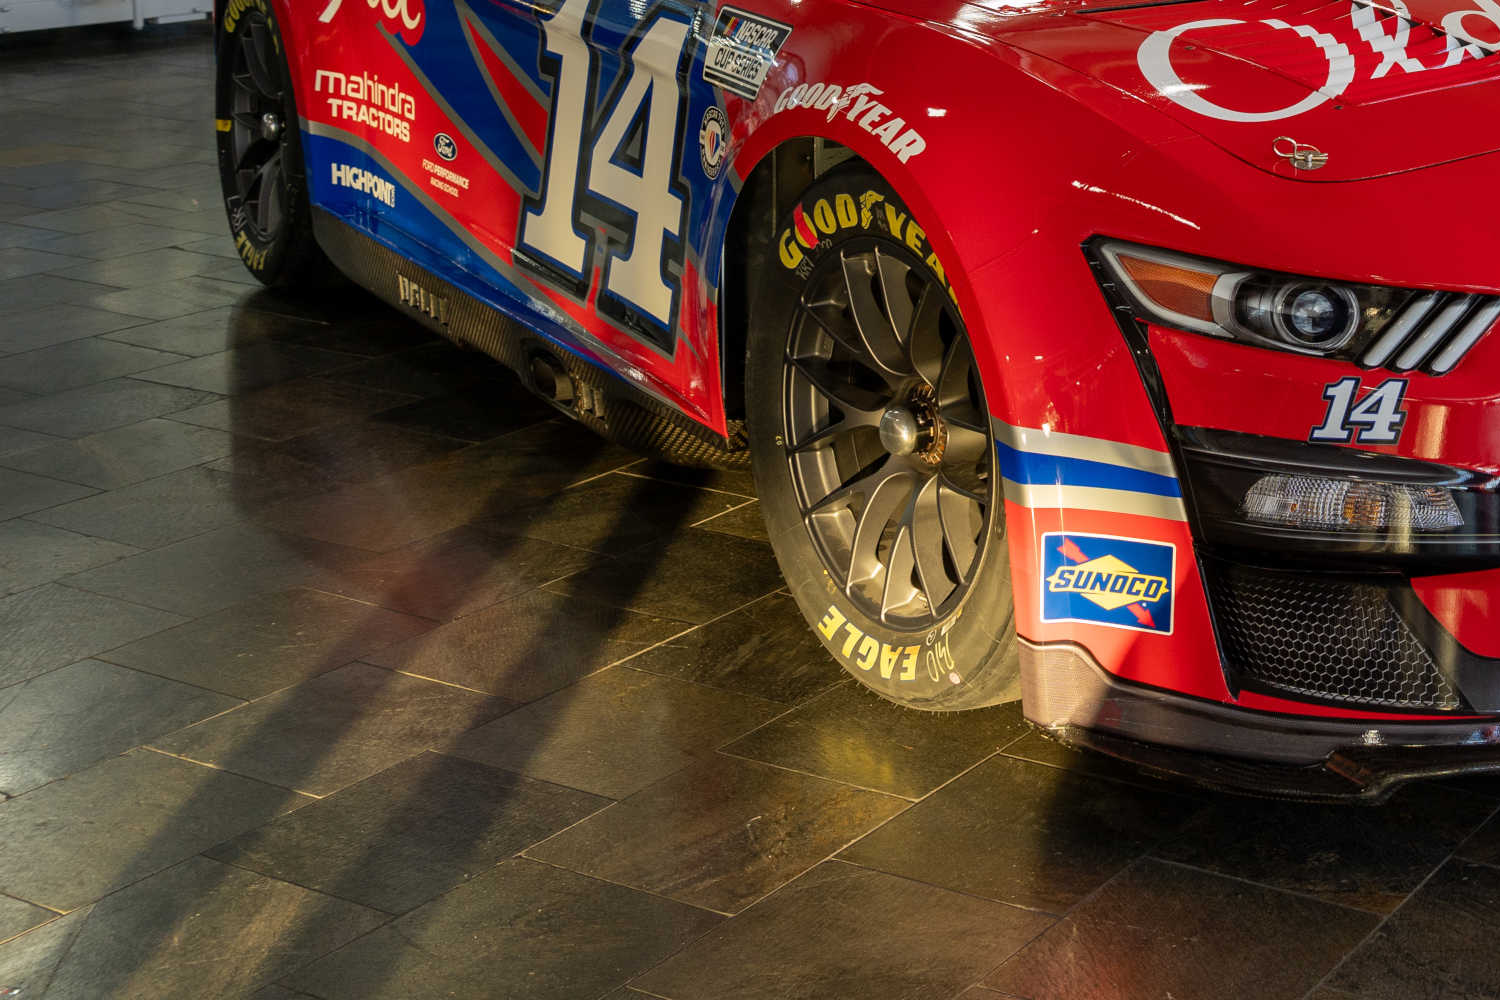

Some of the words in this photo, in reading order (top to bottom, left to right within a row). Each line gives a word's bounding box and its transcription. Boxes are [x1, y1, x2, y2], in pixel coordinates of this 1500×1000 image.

[735, 19, 779, 49] NASCAR
[713, 47, 734, 71] CUP
[733, 53, 763, 81] SERIES
[314, 68, 416, 121] mahindra
[326, 97, 411, 143] TRACTORS
[773, 81, 927, 165] GOODYEAR
[779, 192, 958, 305] GOODYEA
[1309, 376, 1410, 444] 14
[1053, 568, 1165, 600] SUNOCO
[816, 604, 922, 682] EAGLE
